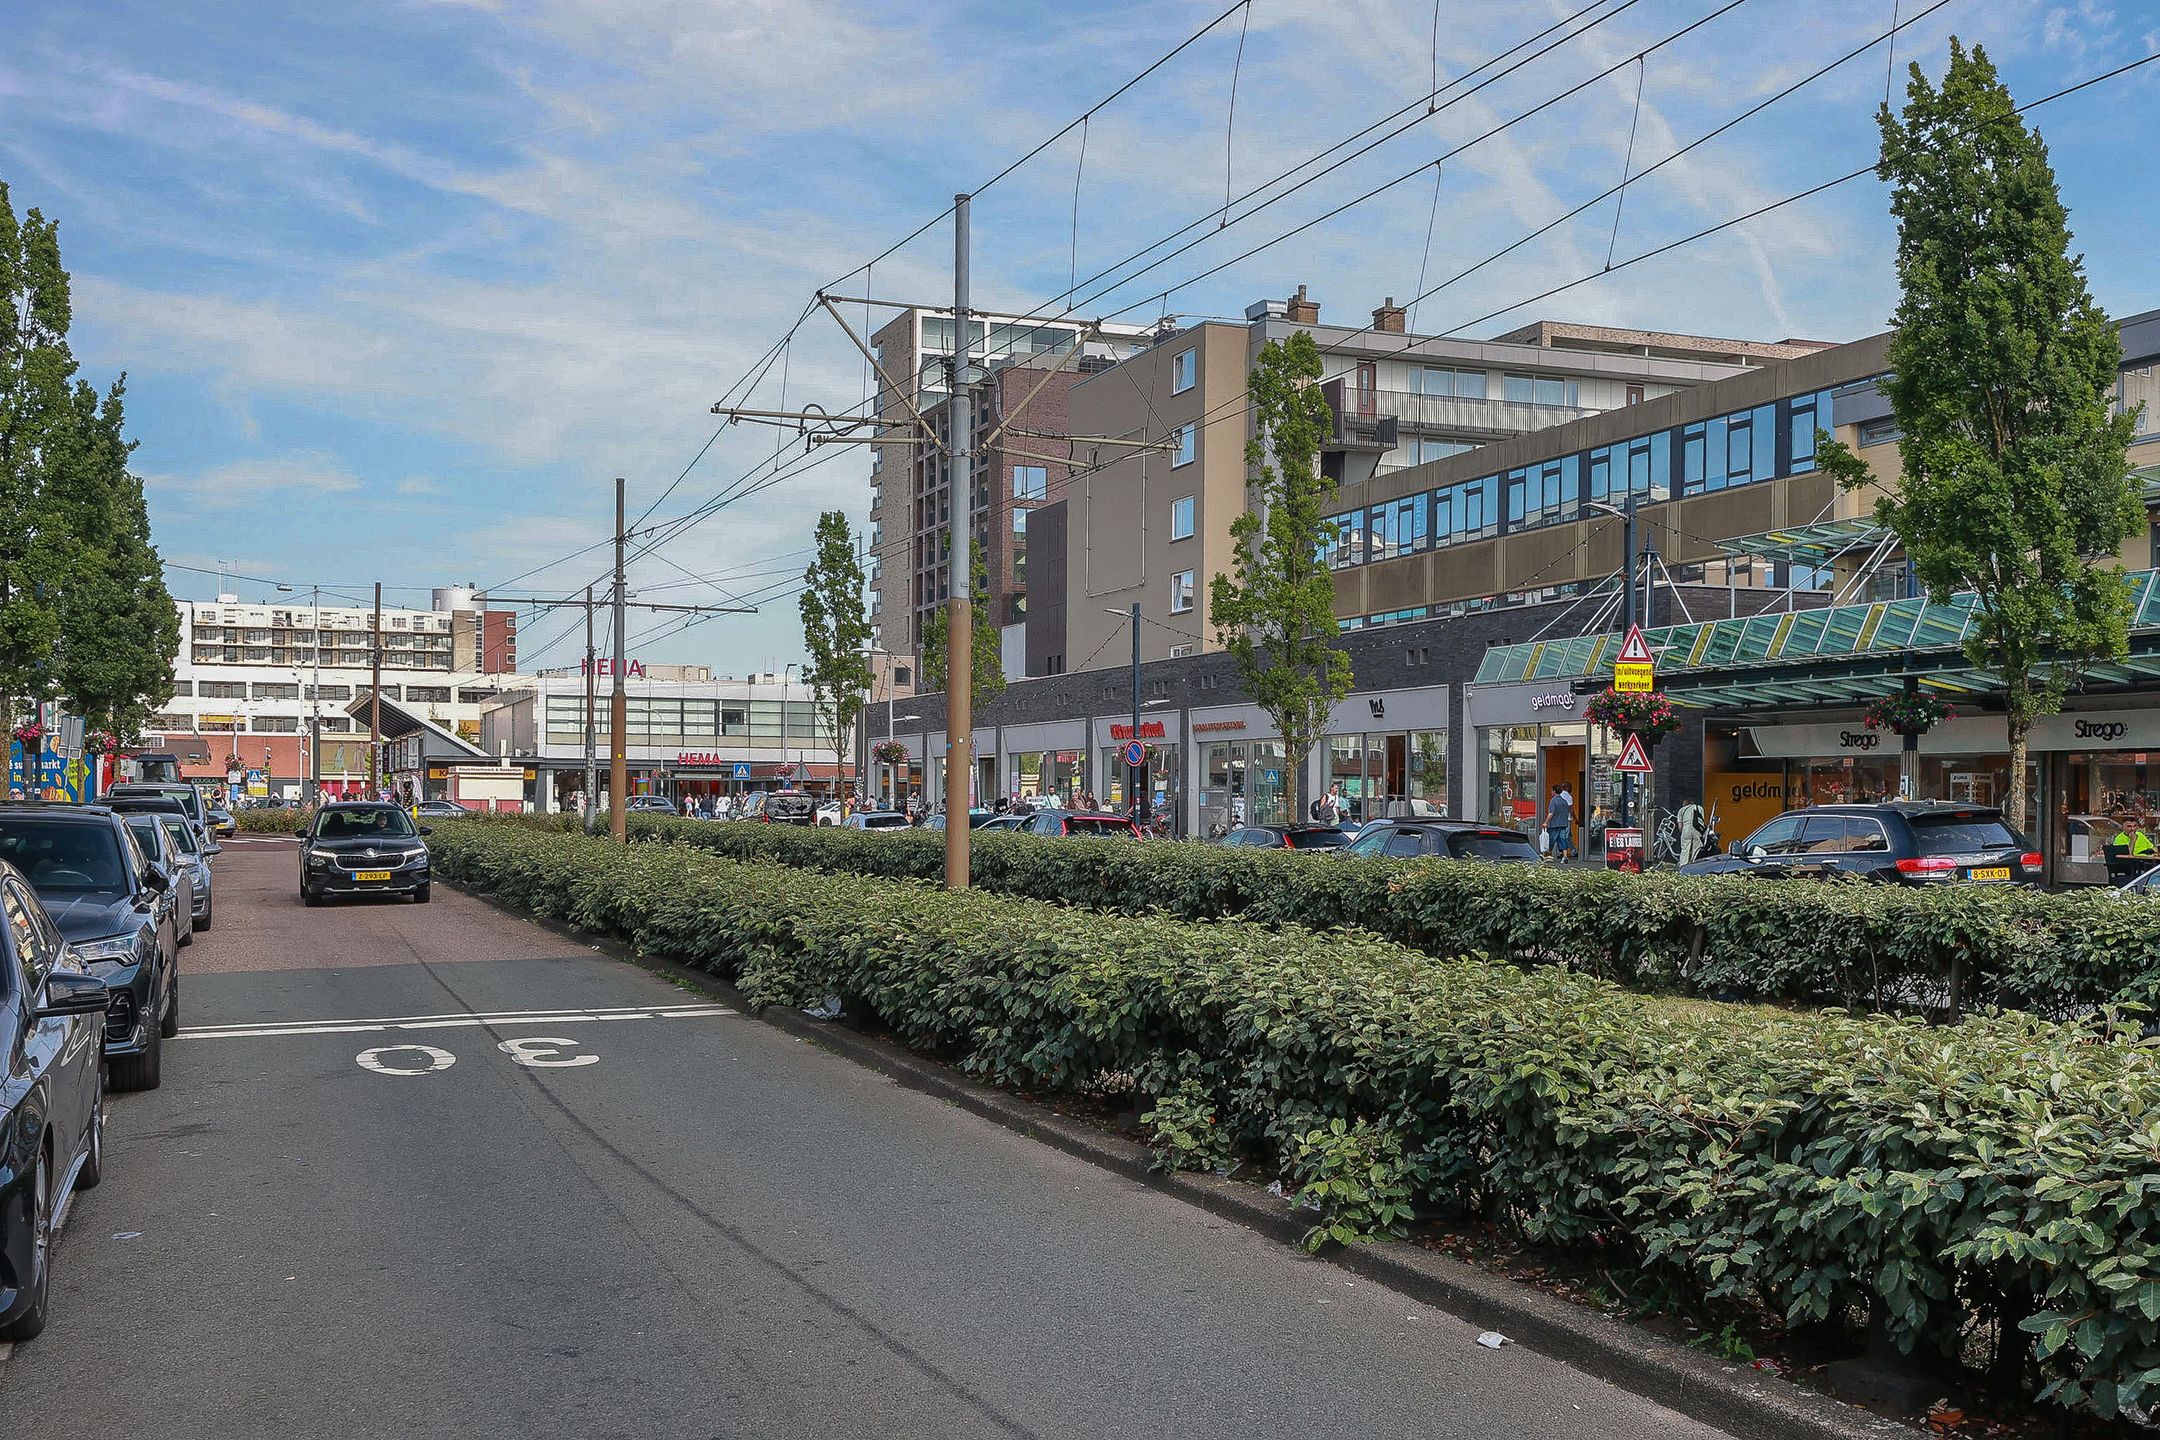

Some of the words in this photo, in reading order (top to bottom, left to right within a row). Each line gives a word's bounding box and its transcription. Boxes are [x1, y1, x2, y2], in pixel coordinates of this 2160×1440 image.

[1618, 680, 1650, 689] werkverkeer
[1532, 692, 1574, 710] geldmaat
[2074, 719, 2125, 741] Strego
[1840, 731, 1878, 750] Strego
[678, 752, 721, 765] HEMA
[1973, 869, 2007, 879] 8-SXK-03
